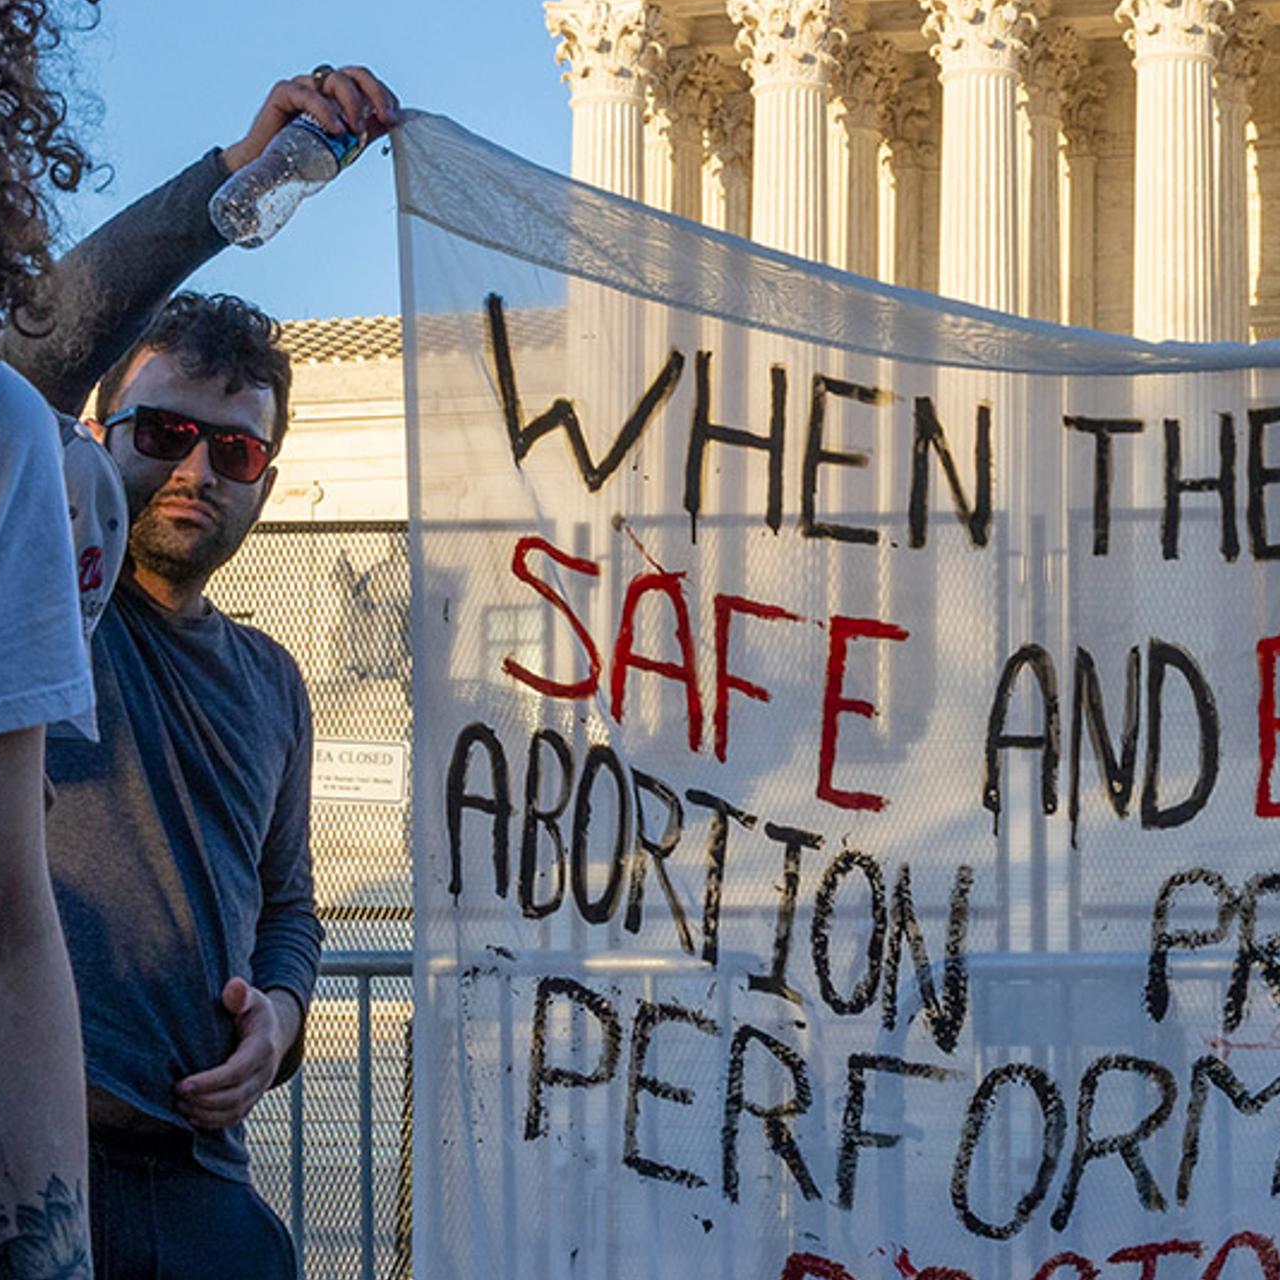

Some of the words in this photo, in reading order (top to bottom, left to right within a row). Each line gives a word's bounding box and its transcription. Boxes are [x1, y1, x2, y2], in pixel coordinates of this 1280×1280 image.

[484, 293, 993, 550] WHEN
[502, 534, 910, 811] SAFE
[982, 638, 1220, 847] AND
[447, 722, 975, 1055] ABORTION
